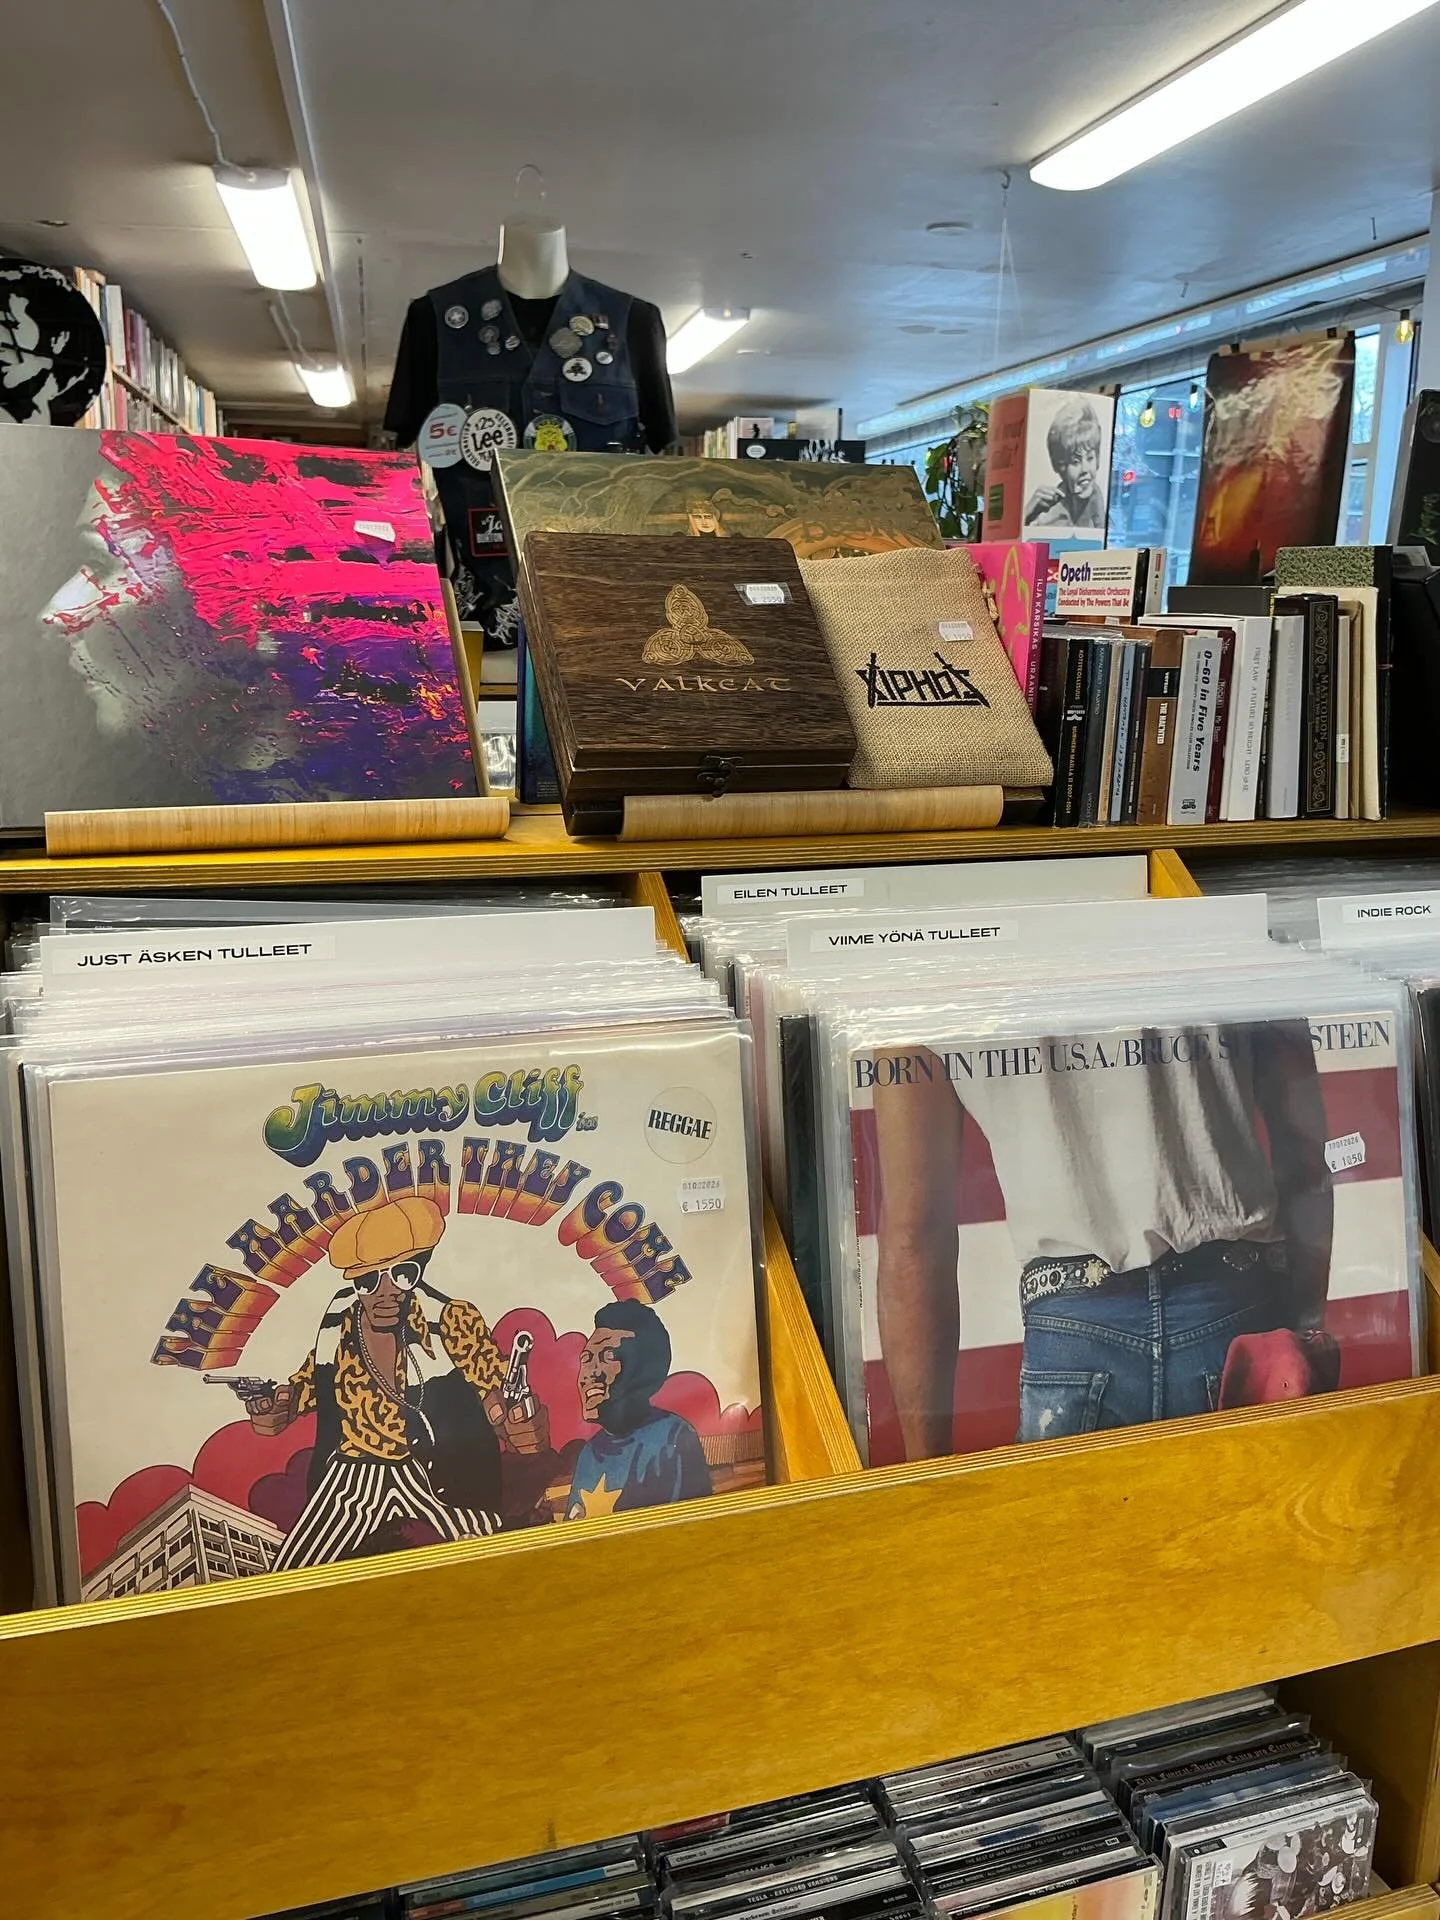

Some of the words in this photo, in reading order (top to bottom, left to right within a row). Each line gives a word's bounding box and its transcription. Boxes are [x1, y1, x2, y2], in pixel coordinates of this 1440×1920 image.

[470, 429, 504, 452] Lee
[1060, 562, 1091, 586] Opeth
[1035, 579, 1044, 598] ILJA
[1031, 601, 1042, 650] KARSIKAS
[1200, 688, 1210, 701] in
[1196, 705, 1208, 732] Five
[1320, 674, 1329, 740] MASTODON
[1193, 736, 1206, 772] Years
[733, 888, 777, 899] EILEN
[780, 884, 848, 897] TULLEET
[1357, 907, 1393, 918] INDIE
[1394, 905, 1432, 916] ROCK
[828, 934, 874, 946] VIIME
[878, 930, 925, 944] YÖNÄ
[927, 927, 1001, 941] TULLEET
[77, 954, 132, 967] JUST
[138, 949, 212, 963] ÄSKEN
[217, 944, 312, 959] TULLEET
[854, 1054, 934, 1089] BORN
[942, 1051, 974, 1081] IN
[978, 1046, 1042, 1078] THE
[263, 1074, 470, 1167] Jimmy
[473, 1064, 585, 1143] Cliff
[647, 1109, 713, 1140] REGGAE
[695, 1198, 722, 1211] 1550
[225, 1138, 451, 1286] HARDER
[458, 1136, 591, 1224] THEY
[560, 1180, 692, 1304] COME
[748, 1891, 769, 1904] TESLA
[774, 1883, 806, 1898] EXTENDED
